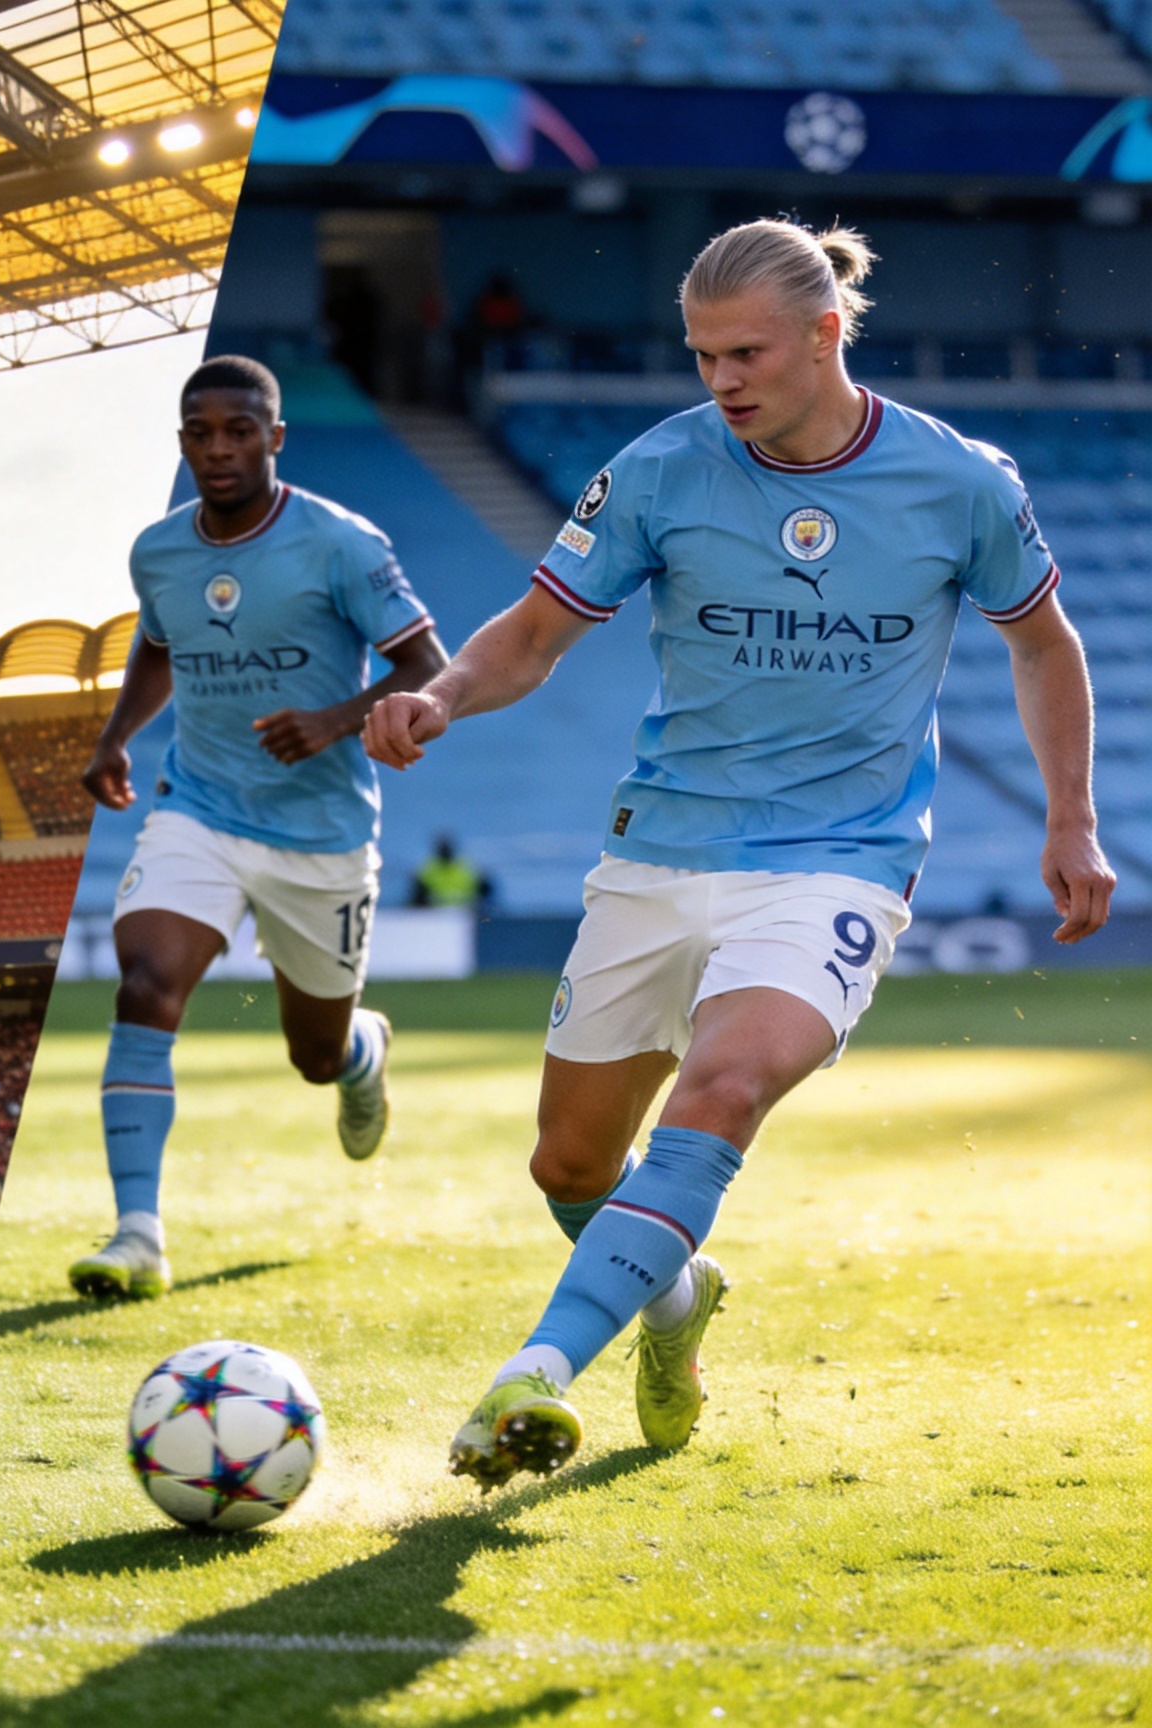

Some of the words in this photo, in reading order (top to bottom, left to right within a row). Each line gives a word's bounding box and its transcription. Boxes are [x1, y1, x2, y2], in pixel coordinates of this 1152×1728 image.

[697, 603, 915, 645] ETIHAD
[732, 643, 873, 674] AIRWAYS
[832, 910, 877, 969] 9
